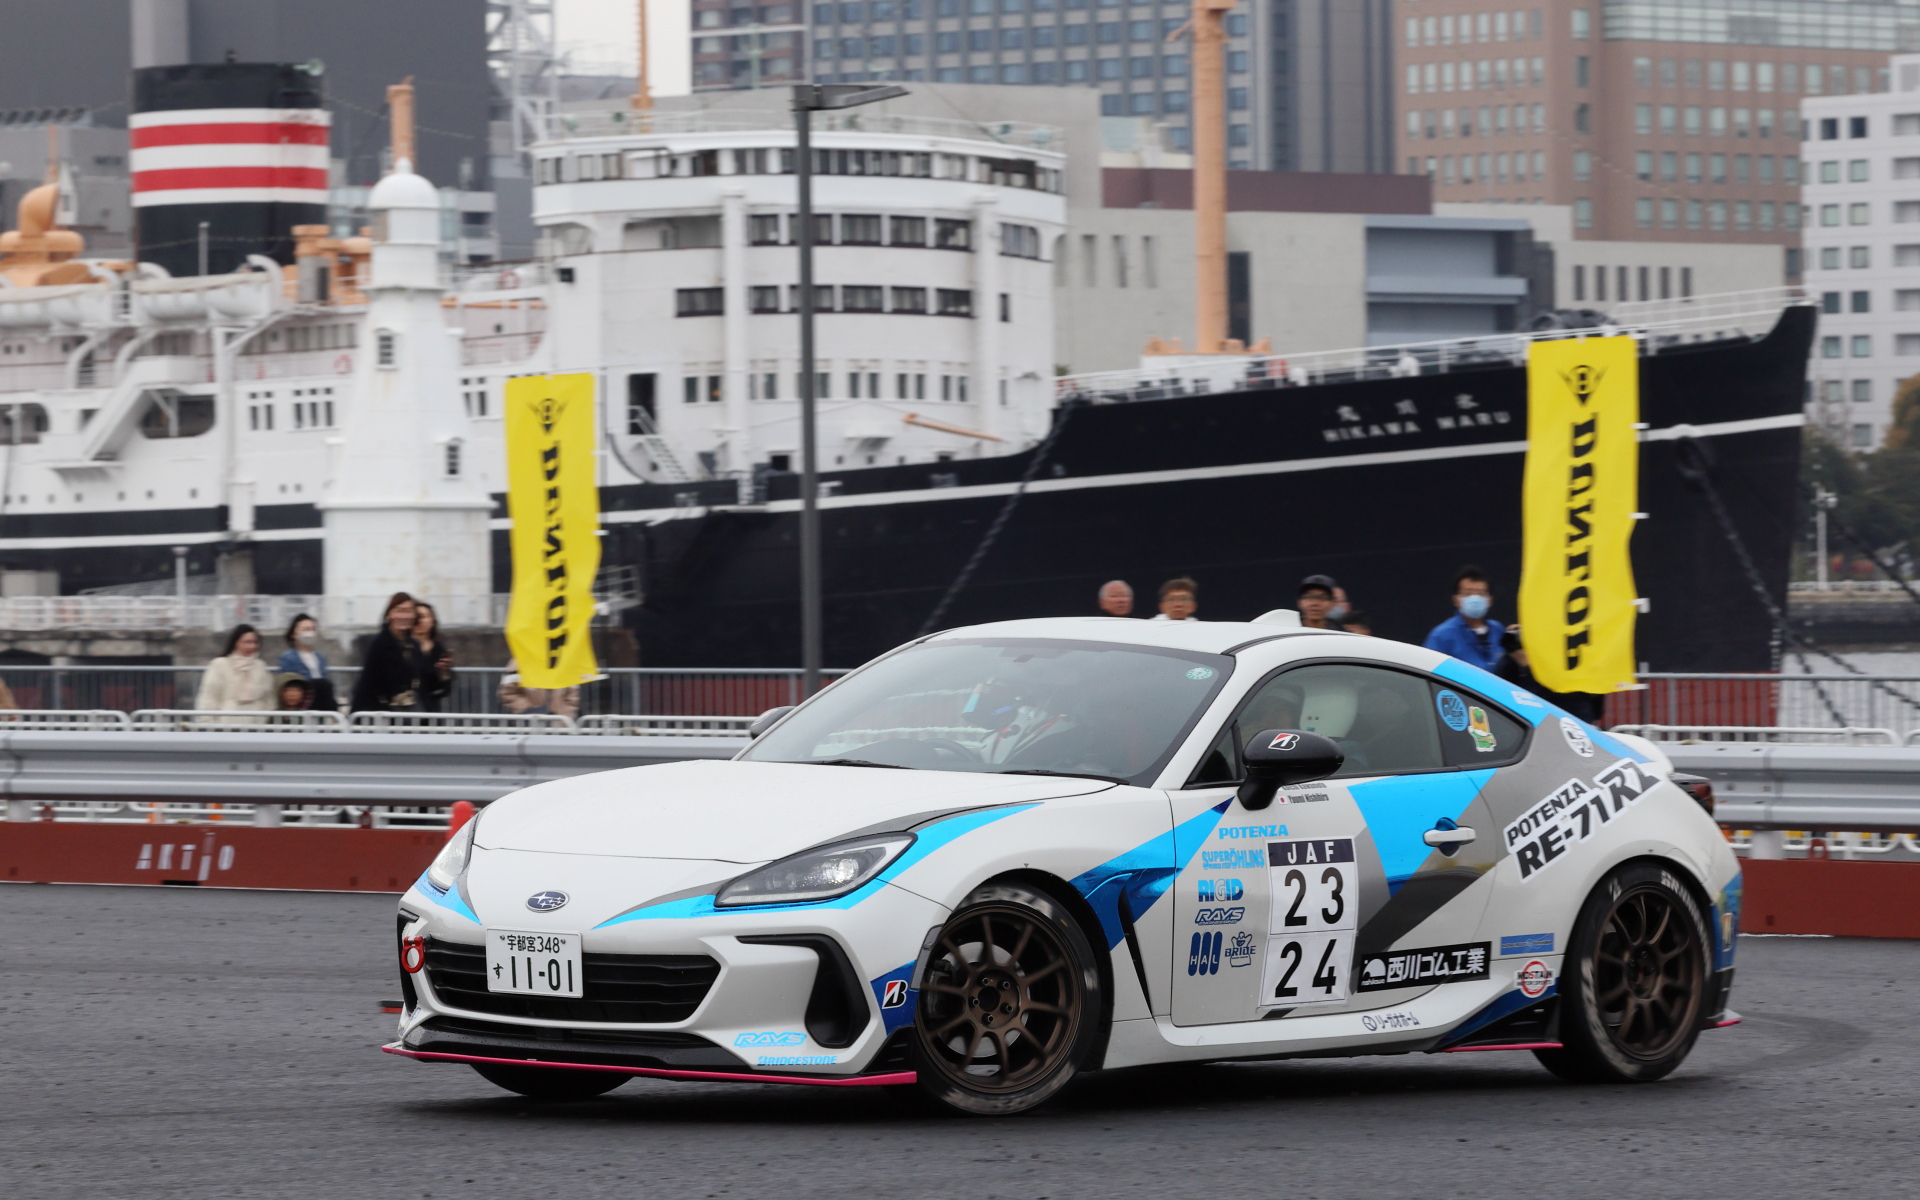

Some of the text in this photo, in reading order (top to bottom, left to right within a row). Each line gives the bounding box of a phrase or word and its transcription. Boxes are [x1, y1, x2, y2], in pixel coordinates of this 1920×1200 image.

[1506, 782, 1588, 847] POTENZA
[1218, 824, 1289, 839] POTENZA
[1287, 841, 1335, 864] JAF
[1197, 879, 1244, 902] RIGID
[1284, 867, 1344, 927] 23
[1195, 907, 1245, 924] RAYS
[1190, 954, 1218, 966] HAL
[1225, 946, 1257, 957] BRIDE
[493, 956, 573, 992] す 11-01
[1275, 938, 1338, 998] 24
[1386, 948, 1486, 983] 西川ゴム工業
[734, 1032, 807, 1047] RAYS
[757, 1056, 838, 1067] BRIDGESTONE
